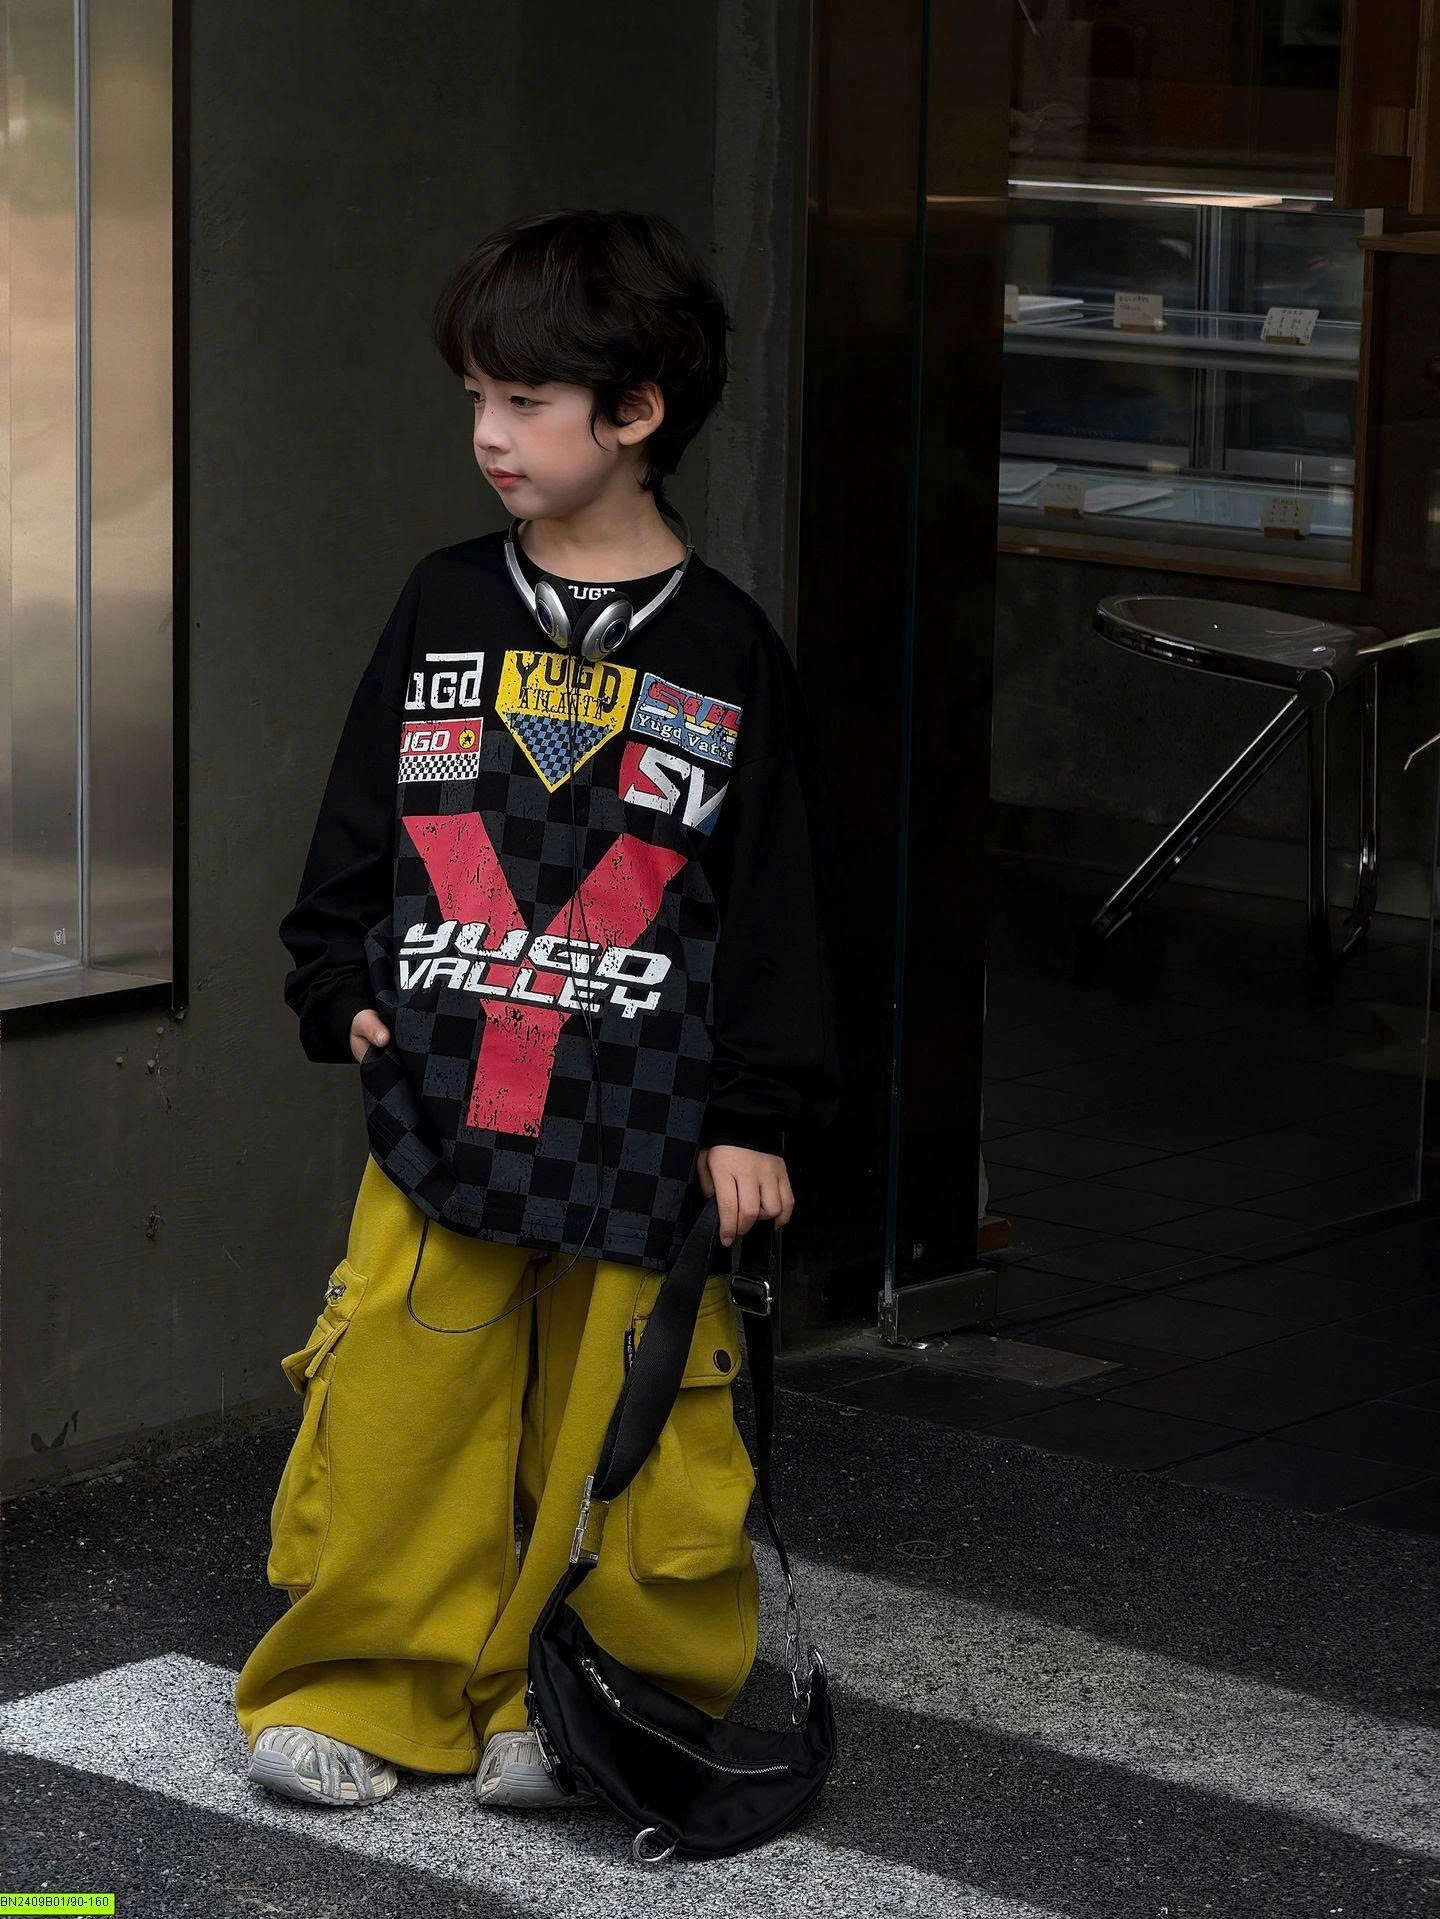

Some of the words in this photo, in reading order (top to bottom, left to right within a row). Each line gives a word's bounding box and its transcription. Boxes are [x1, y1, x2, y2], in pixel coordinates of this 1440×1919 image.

[568, 585, 616, 601] UG
[515, 653, 622, 713] YUGD
[638, 713, 682, 740] Yugd
[399, 920, 672, 985] YUGD
[399, 956, 661, 1019] VALLEY
